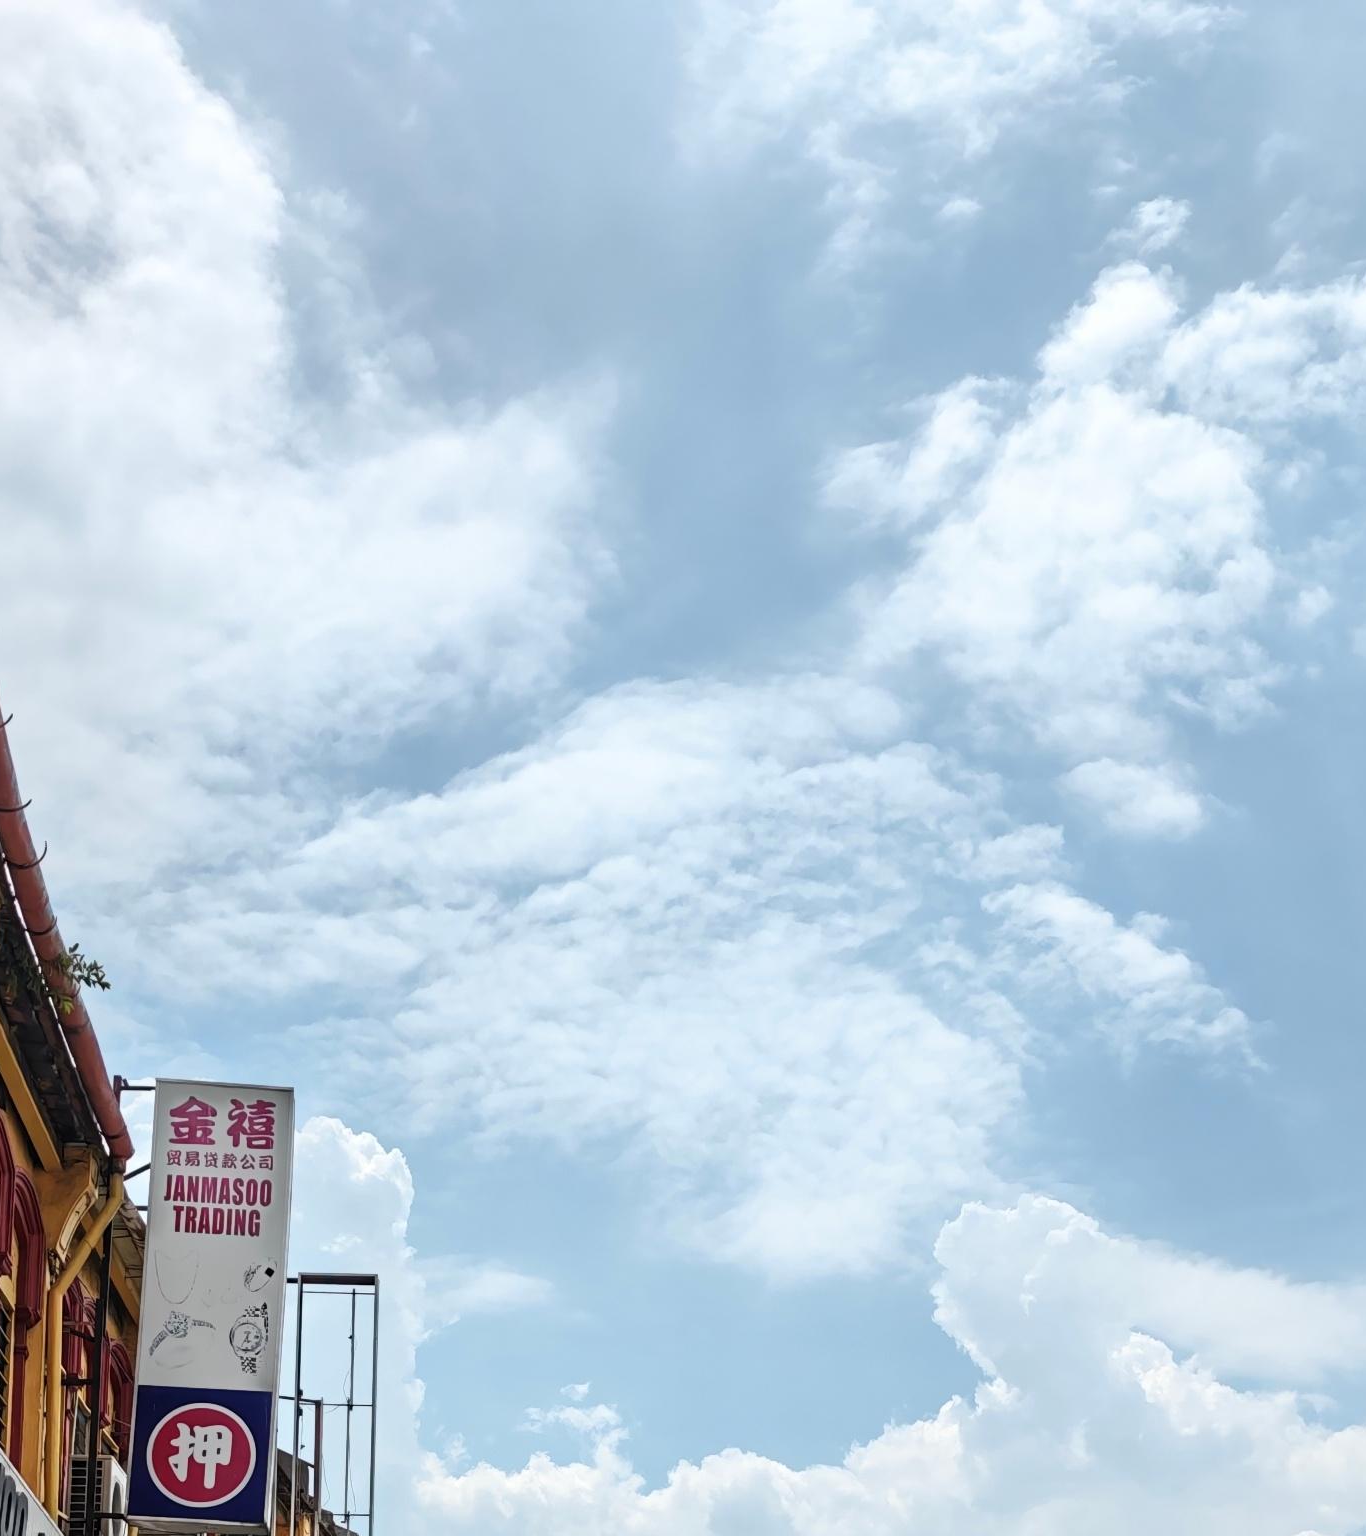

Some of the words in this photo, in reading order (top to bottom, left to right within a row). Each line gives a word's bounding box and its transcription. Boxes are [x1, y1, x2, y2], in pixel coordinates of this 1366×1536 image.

[169, 1096, 276, 1150] 金禧
[166, 1150, 274, 1171] 贸易贷款公司
[163, 1174, 273, 1207] JANMASOO
[173, 1206, 261, 1237] TRADING
[168, 1423, 232, 1489] 押
